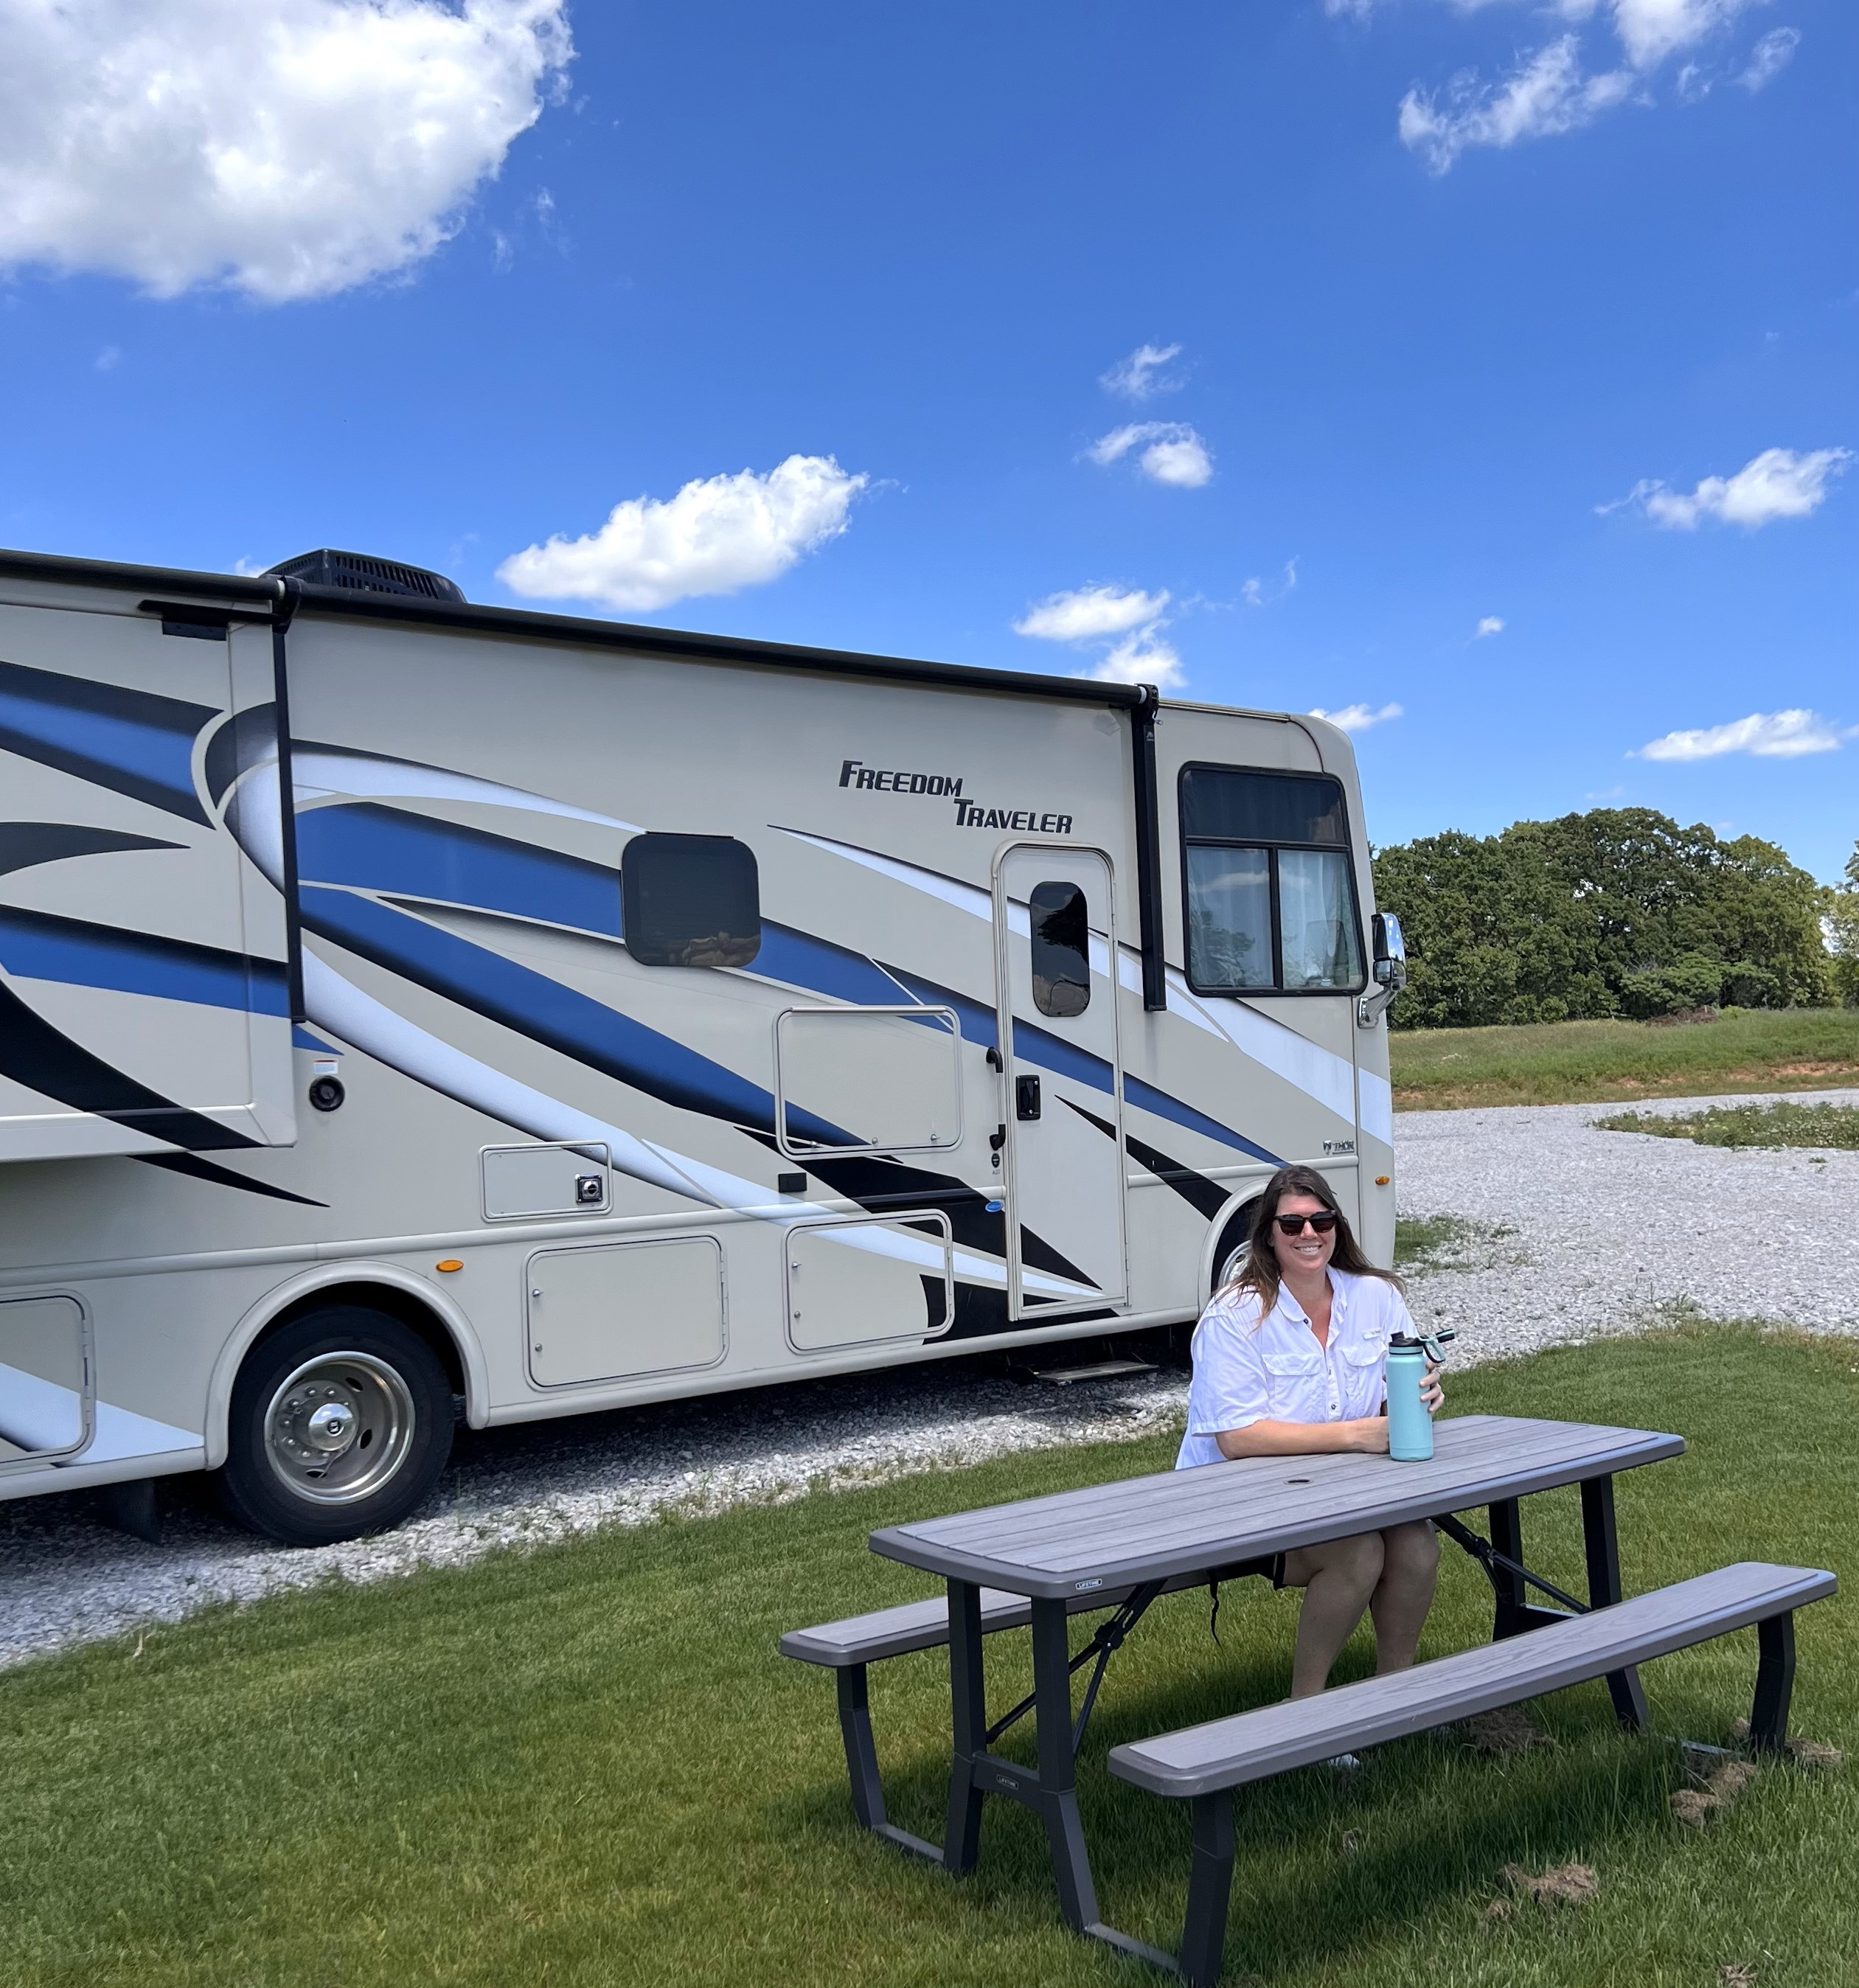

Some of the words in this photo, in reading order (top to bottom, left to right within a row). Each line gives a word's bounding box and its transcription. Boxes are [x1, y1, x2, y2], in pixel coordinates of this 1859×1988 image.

[838, 760, 963, 797] FREEDOM
[953, 798, 1072, 834] TRAVELER
[1332, 1140, 1355, 1150] THOR
